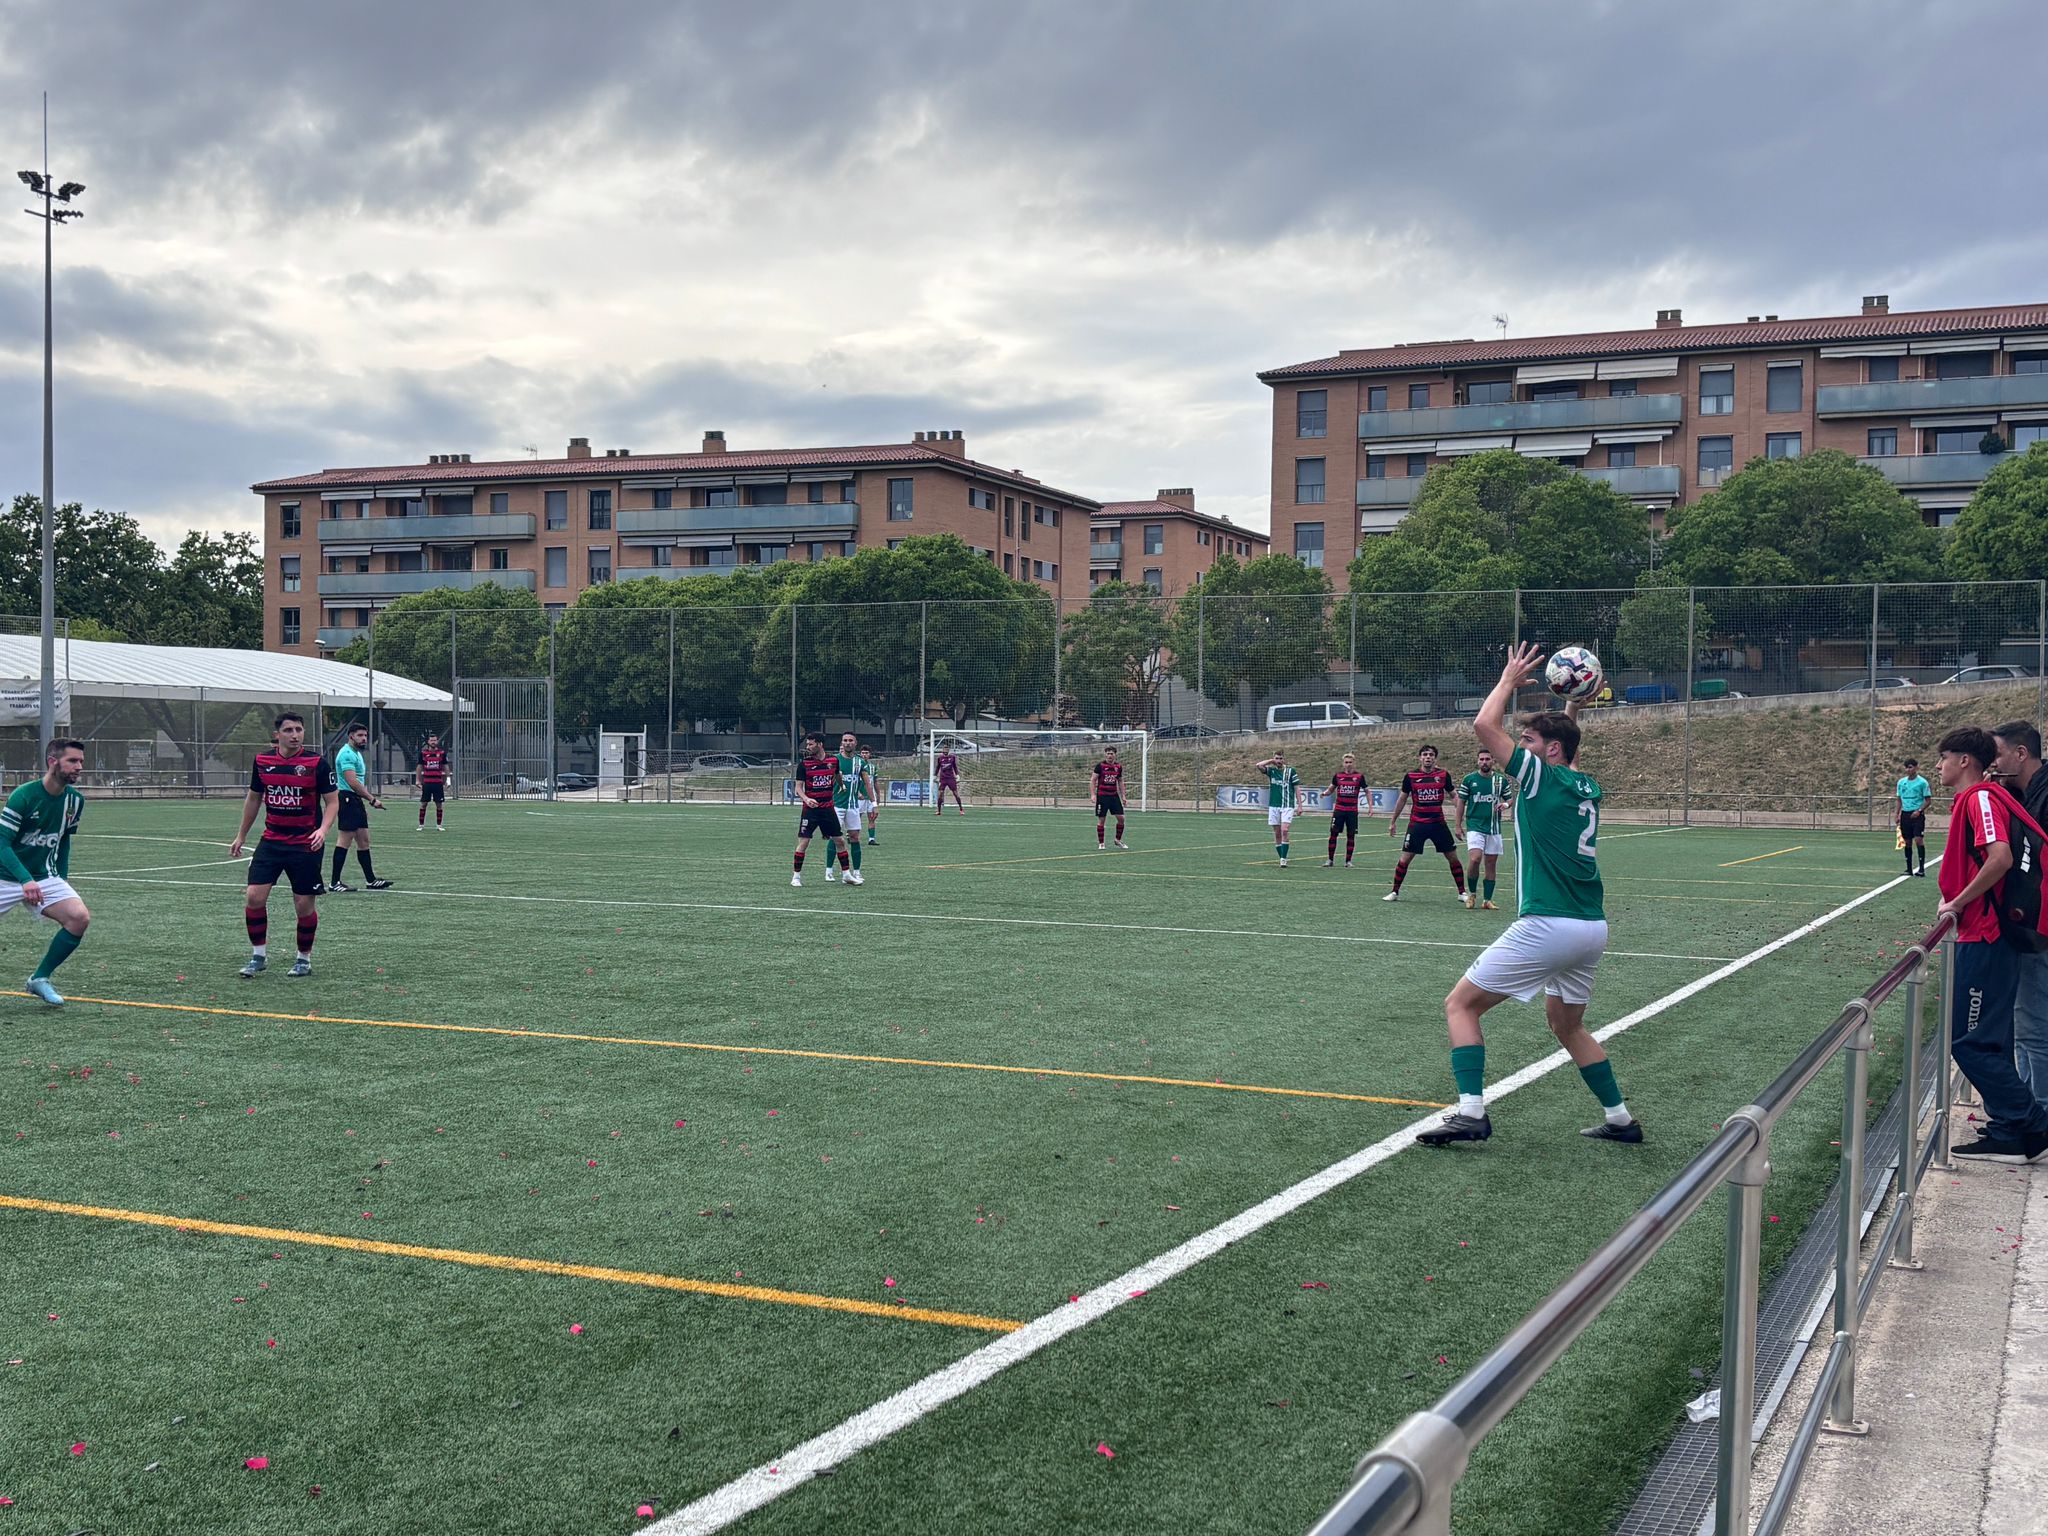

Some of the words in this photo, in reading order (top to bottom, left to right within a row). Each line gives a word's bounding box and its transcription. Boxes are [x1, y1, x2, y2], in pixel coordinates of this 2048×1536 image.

[266, 784, 303, 796] SANT
[1231, 790, 1259, 804] IDR
[268, 795, 303, 806] CUGAT
[1578, 800, 1596, 857] 2
[1968, 987, 1983, 1032] Joma
